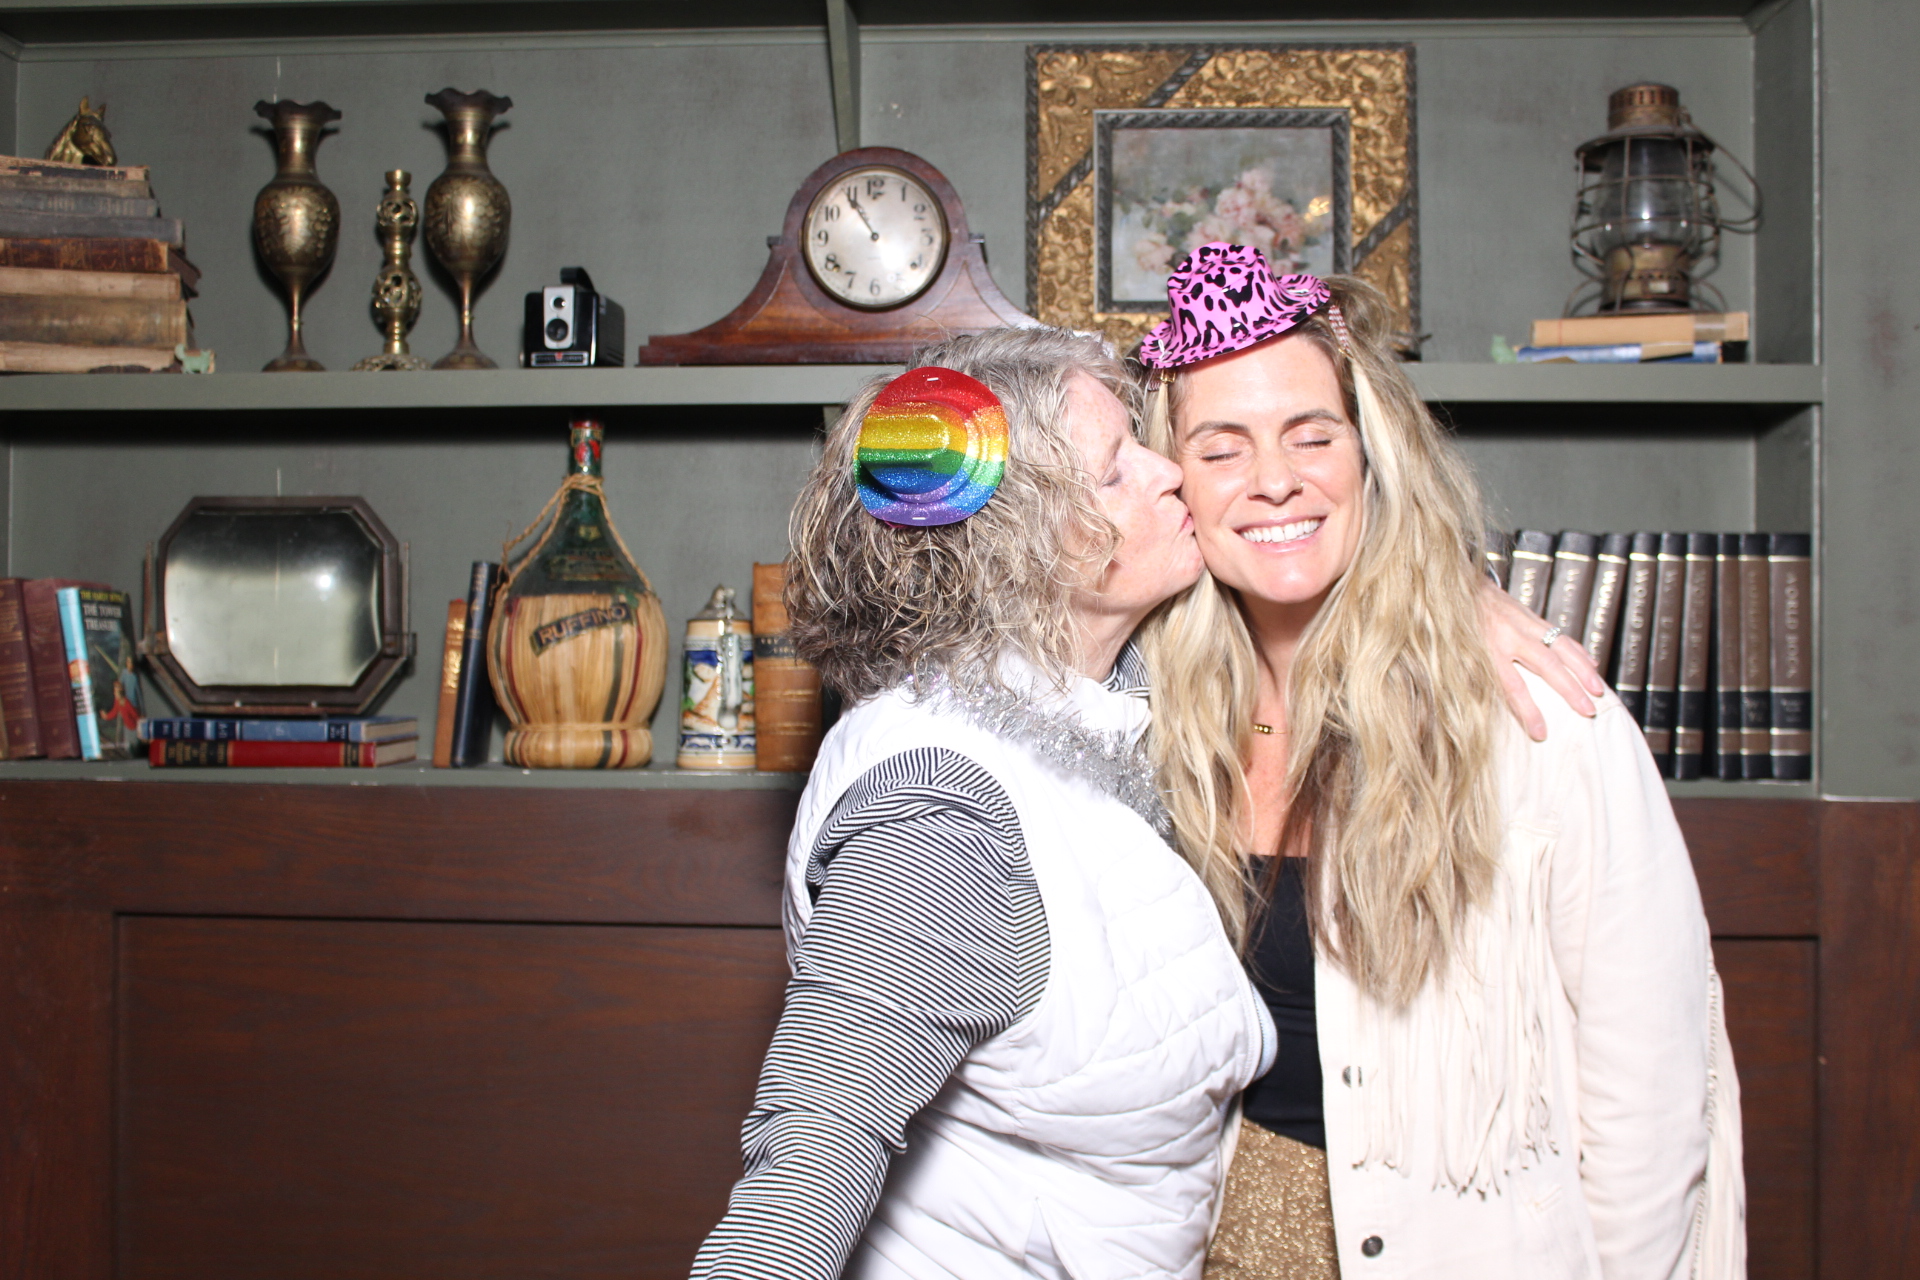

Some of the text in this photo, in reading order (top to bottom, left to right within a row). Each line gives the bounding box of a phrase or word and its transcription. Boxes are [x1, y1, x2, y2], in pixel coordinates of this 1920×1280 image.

[867, 178, 885, 200] 12
[901, 183, 907, 202] 1
[824, 204, 841, 222] 10
[817, 230, 829, 247] 9
[824, 253, 839, 272] 8
[845, 270, 856, 289] 7
[869, 277, 881, 296] 6
[1520, 567, 1537, 606] WOR
[1629, 568, 1650, 629] WORLD
[82, 603, 122, 618] THE TOWER
[538, 605, 626, 644] RUFFINO
